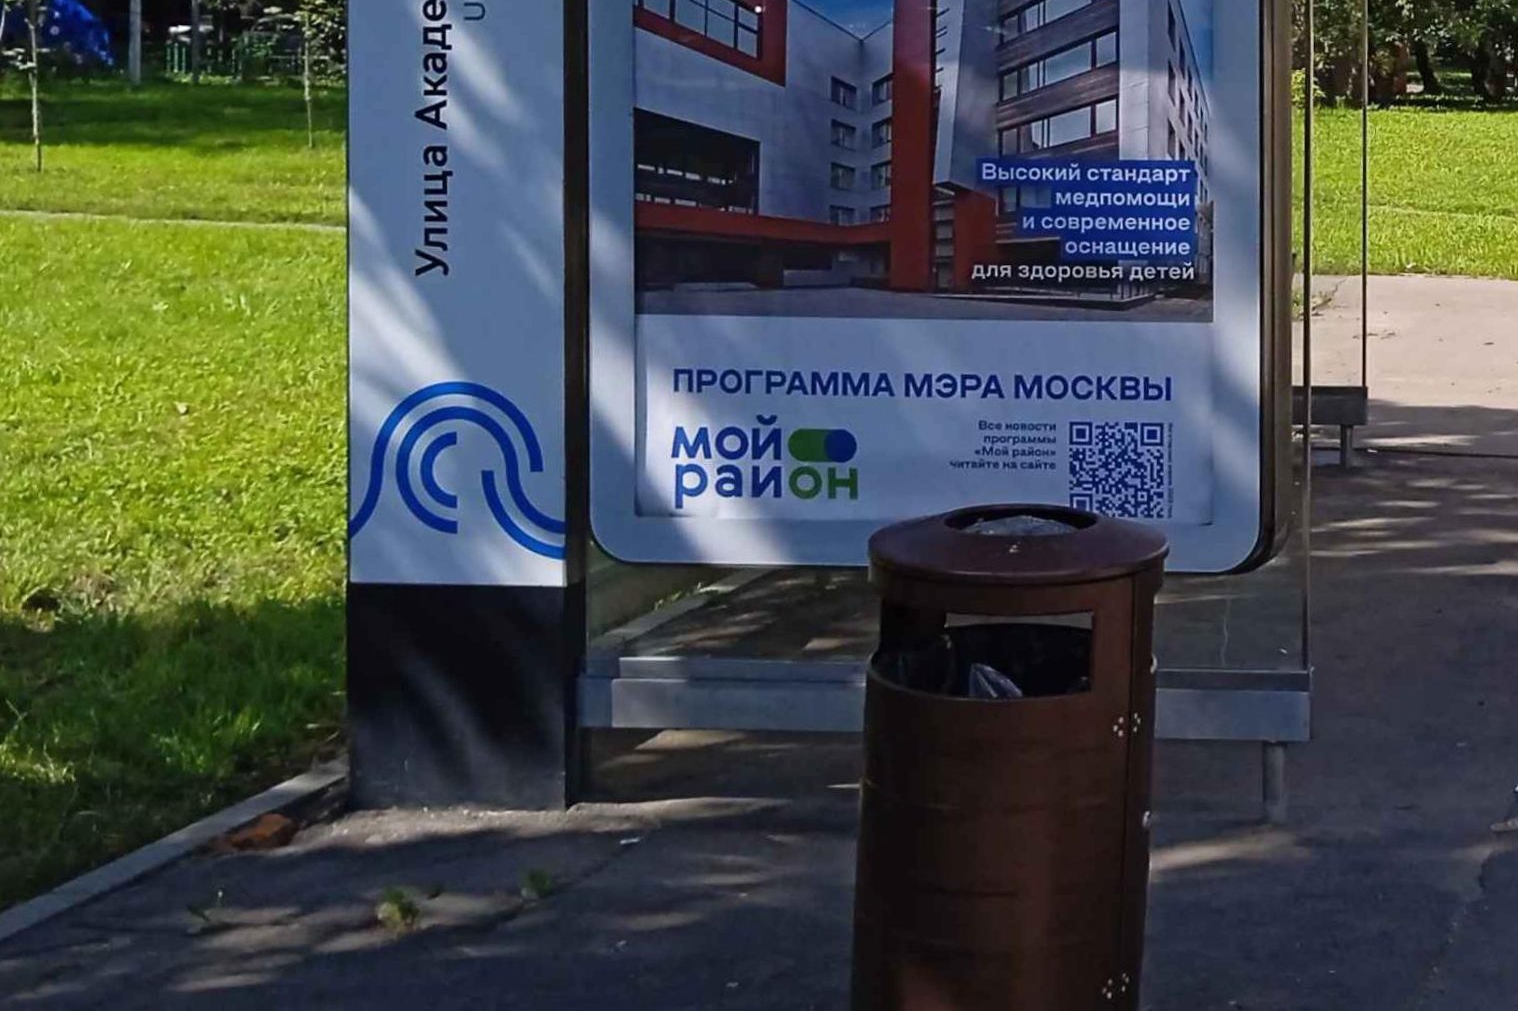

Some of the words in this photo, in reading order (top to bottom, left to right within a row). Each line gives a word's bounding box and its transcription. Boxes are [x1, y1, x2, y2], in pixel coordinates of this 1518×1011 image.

[982, 162, 1081, 181] Высокий
[1087, 168, 1191, 185] стандарт
[1056, 193, 1190, 208] медпомощи
[415, 145, 453, 277] Улица
[1022, 216, 1035, 229] и
[1041, 217, 1191, 233] современное
[1065, 241, 1191, 256] оснащение
[971, 264, 1012, 280] для
[1018, 264, 1123, 282] здоровья
[1129, 261, 1194, 281] детей
[673, 368, 895, 397] ПРОГРАММА
[904, 372, 1005, 399] МЭРА
[1014, 374, 1172, 402] МОСКВЫ
[978, 419, 1003, 431] Все
[1005, 422, 1057, 432] новости
[984, 435, 1057, 446] программы
[950, 458, 1000, 469] читайте
[1003, 461, 1018, 469] на
[1020, 459, 1056, 470] сайте
